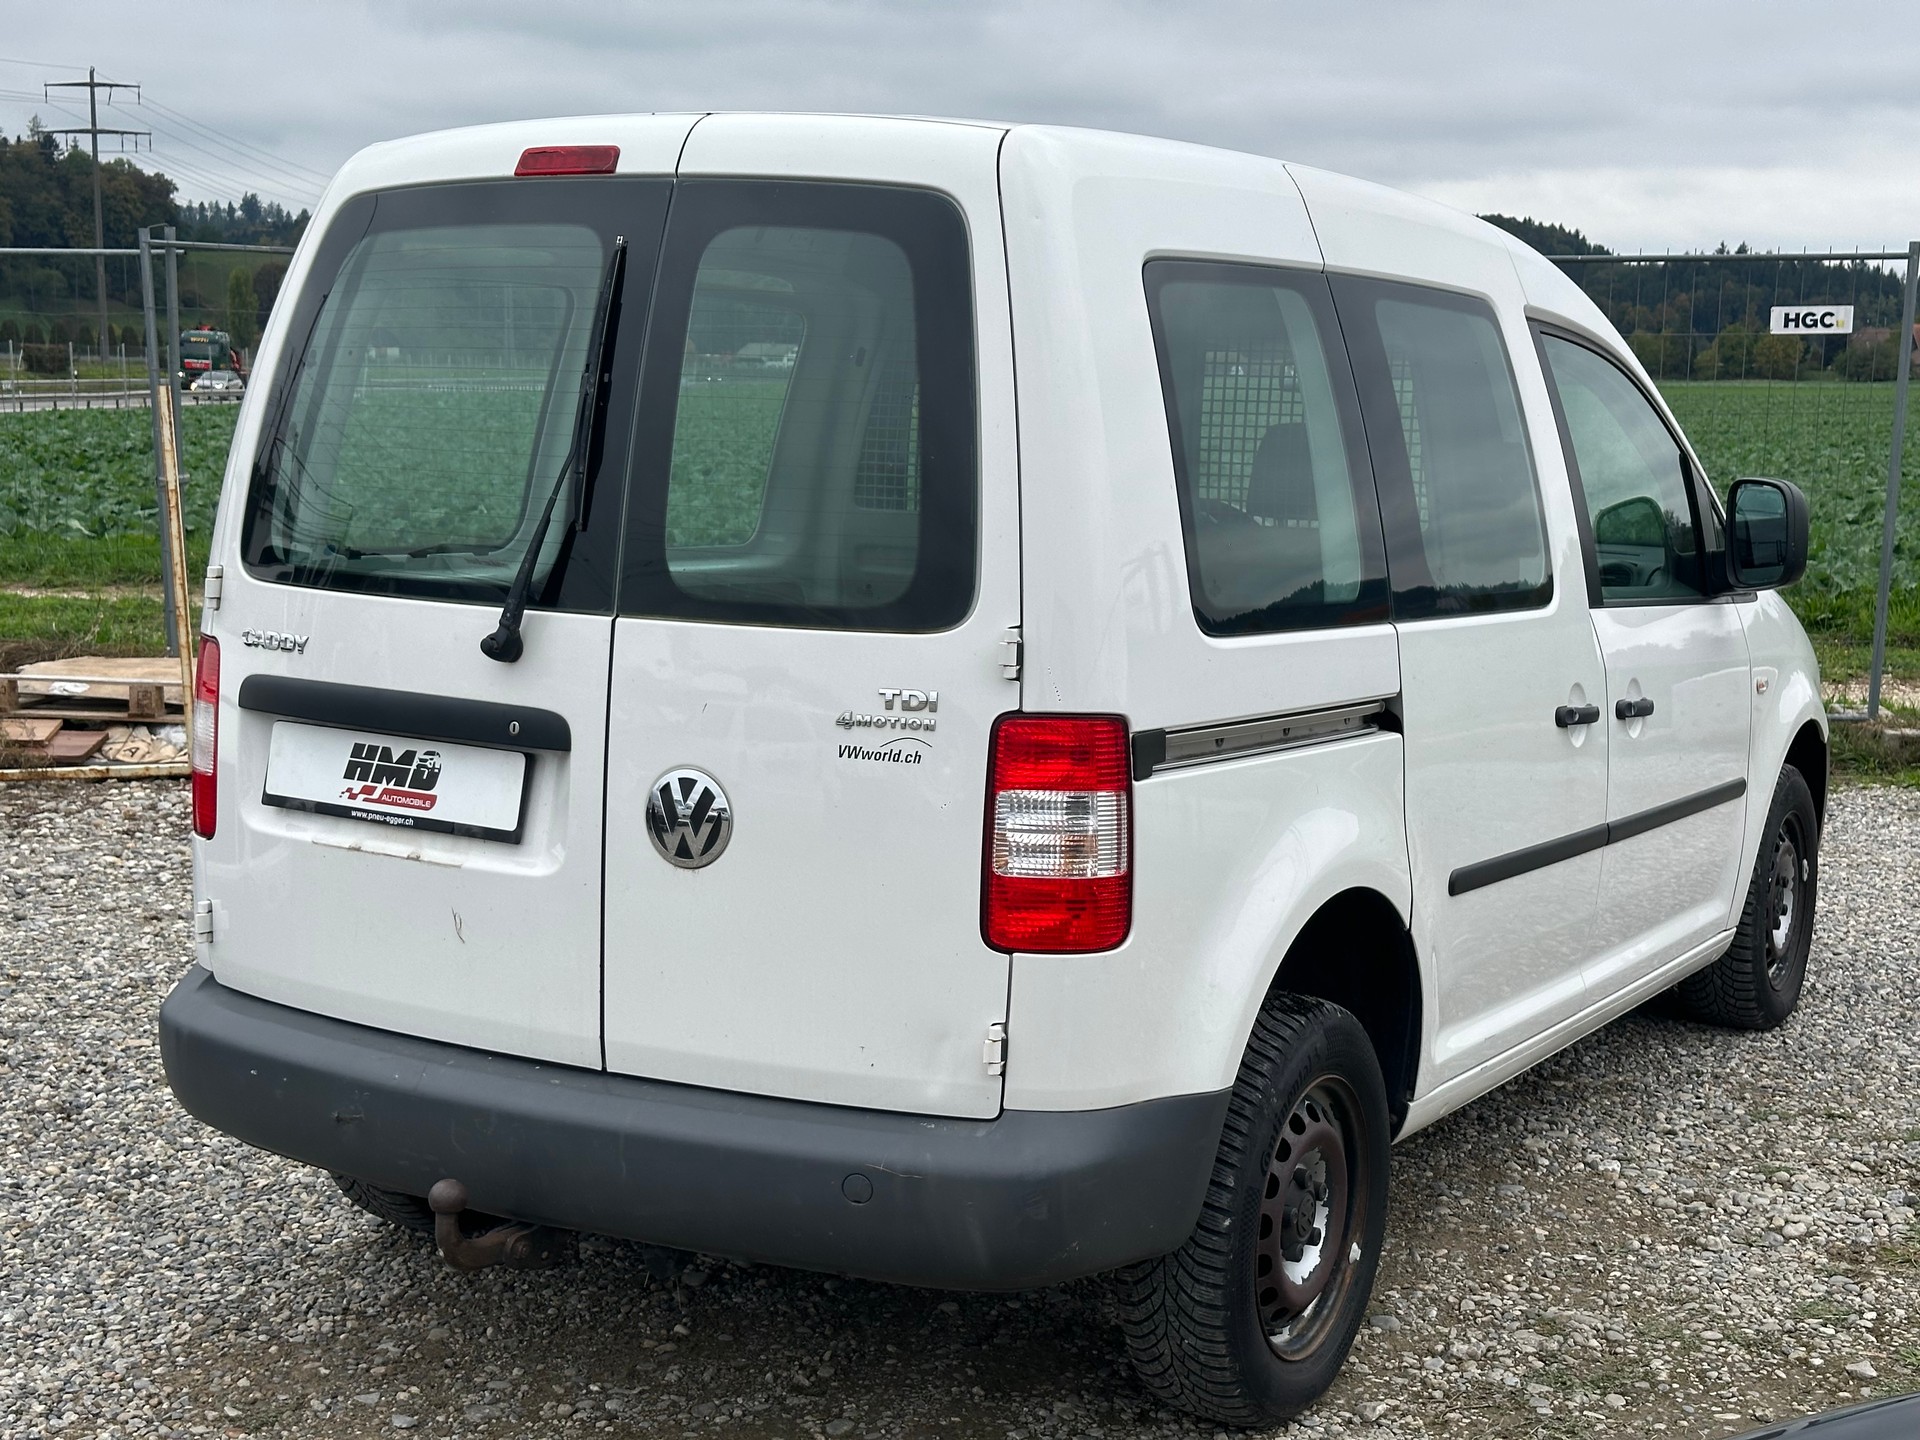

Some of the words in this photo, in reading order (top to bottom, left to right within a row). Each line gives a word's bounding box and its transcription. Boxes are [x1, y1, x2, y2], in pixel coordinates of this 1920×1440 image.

[1783, 311, 1835, 329] HGC
[242, 627, 310, 655] CADDY
[878, 687, 939, 713] TDI
[836, 710, 937, 732] 4MOTION
[838, 744, 922, 764] VWworld.ch
[381, 793, 432, 809] AUTOMOBILE
[351, 809, 414, 826] www.pneu-egger.ch
